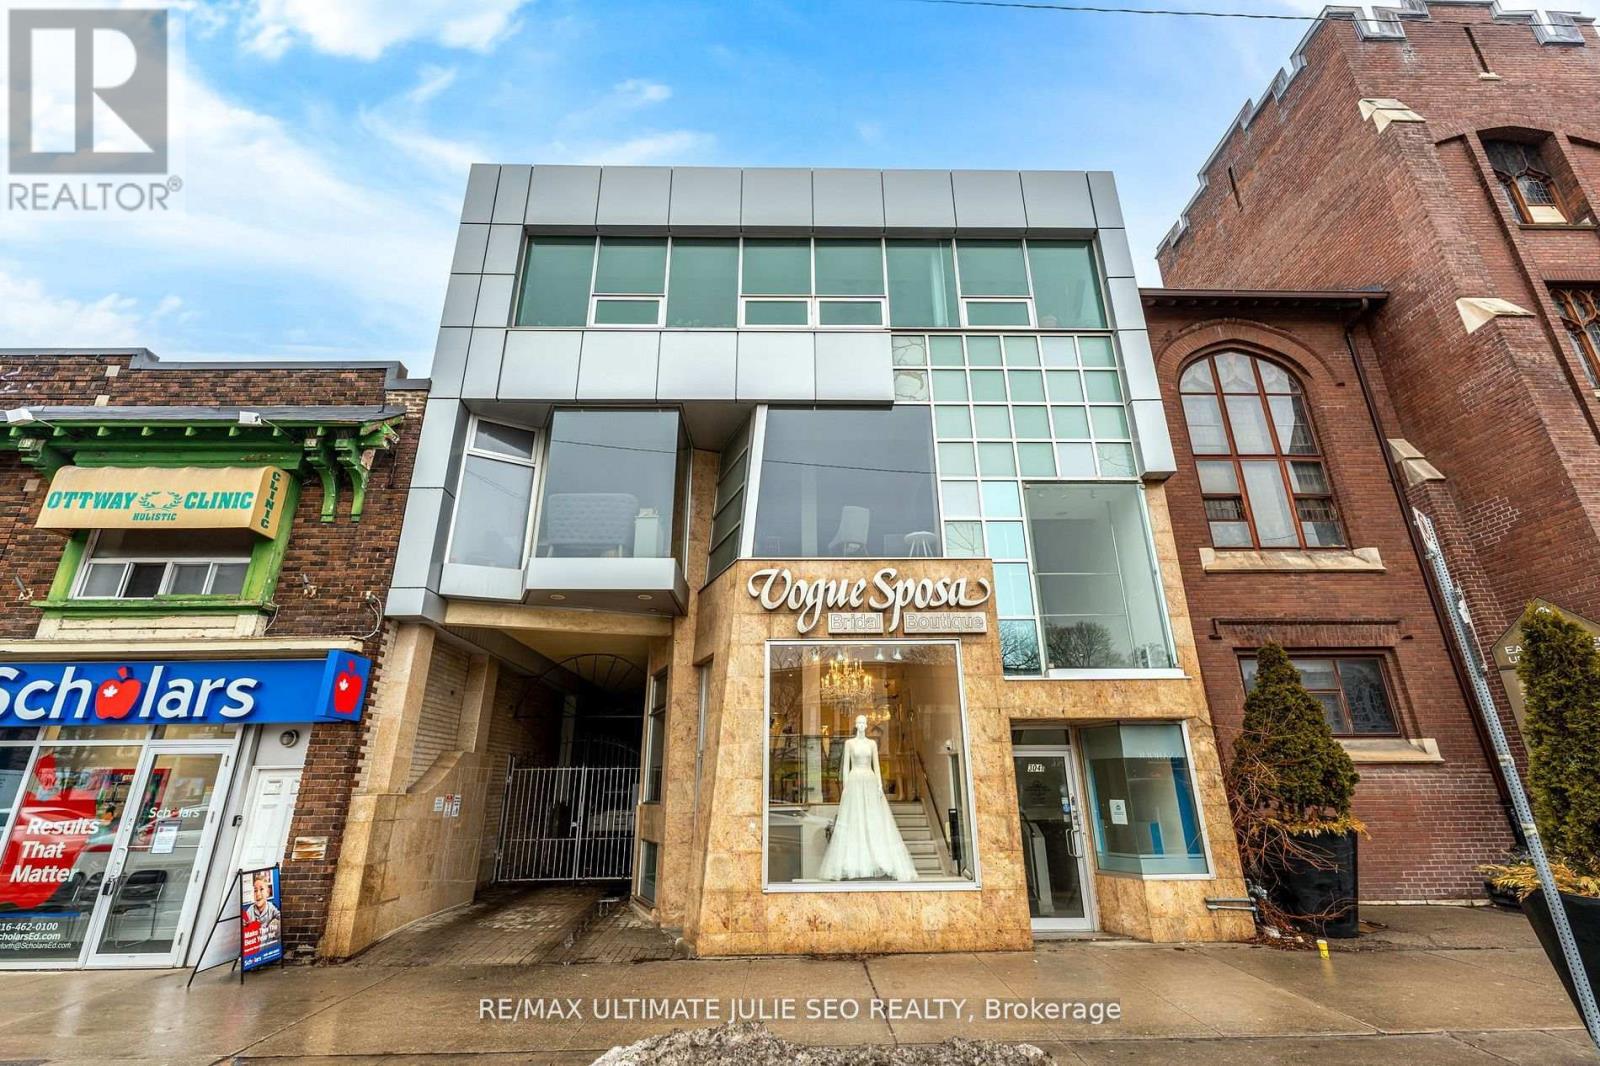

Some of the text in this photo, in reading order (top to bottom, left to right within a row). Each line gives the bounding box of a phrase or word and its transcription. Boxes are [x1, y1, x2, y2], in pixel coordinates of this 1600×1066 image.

[47, 491, 254, 510] OTTWAY CLINIC
[260, 470, 282, 530] CLINIC
[132, 512, 177, 522] HOLISTIC
[747, 567, 992, 634] Vogue Sposa
[829, 613, 985, 632] Bridal Boutique
[26, 817, 101, 835] Results
[21, 840, 66, 859] That
[9, 864, 79, 883] Matter
[0, 922, 59, 931] 16-462-0100
